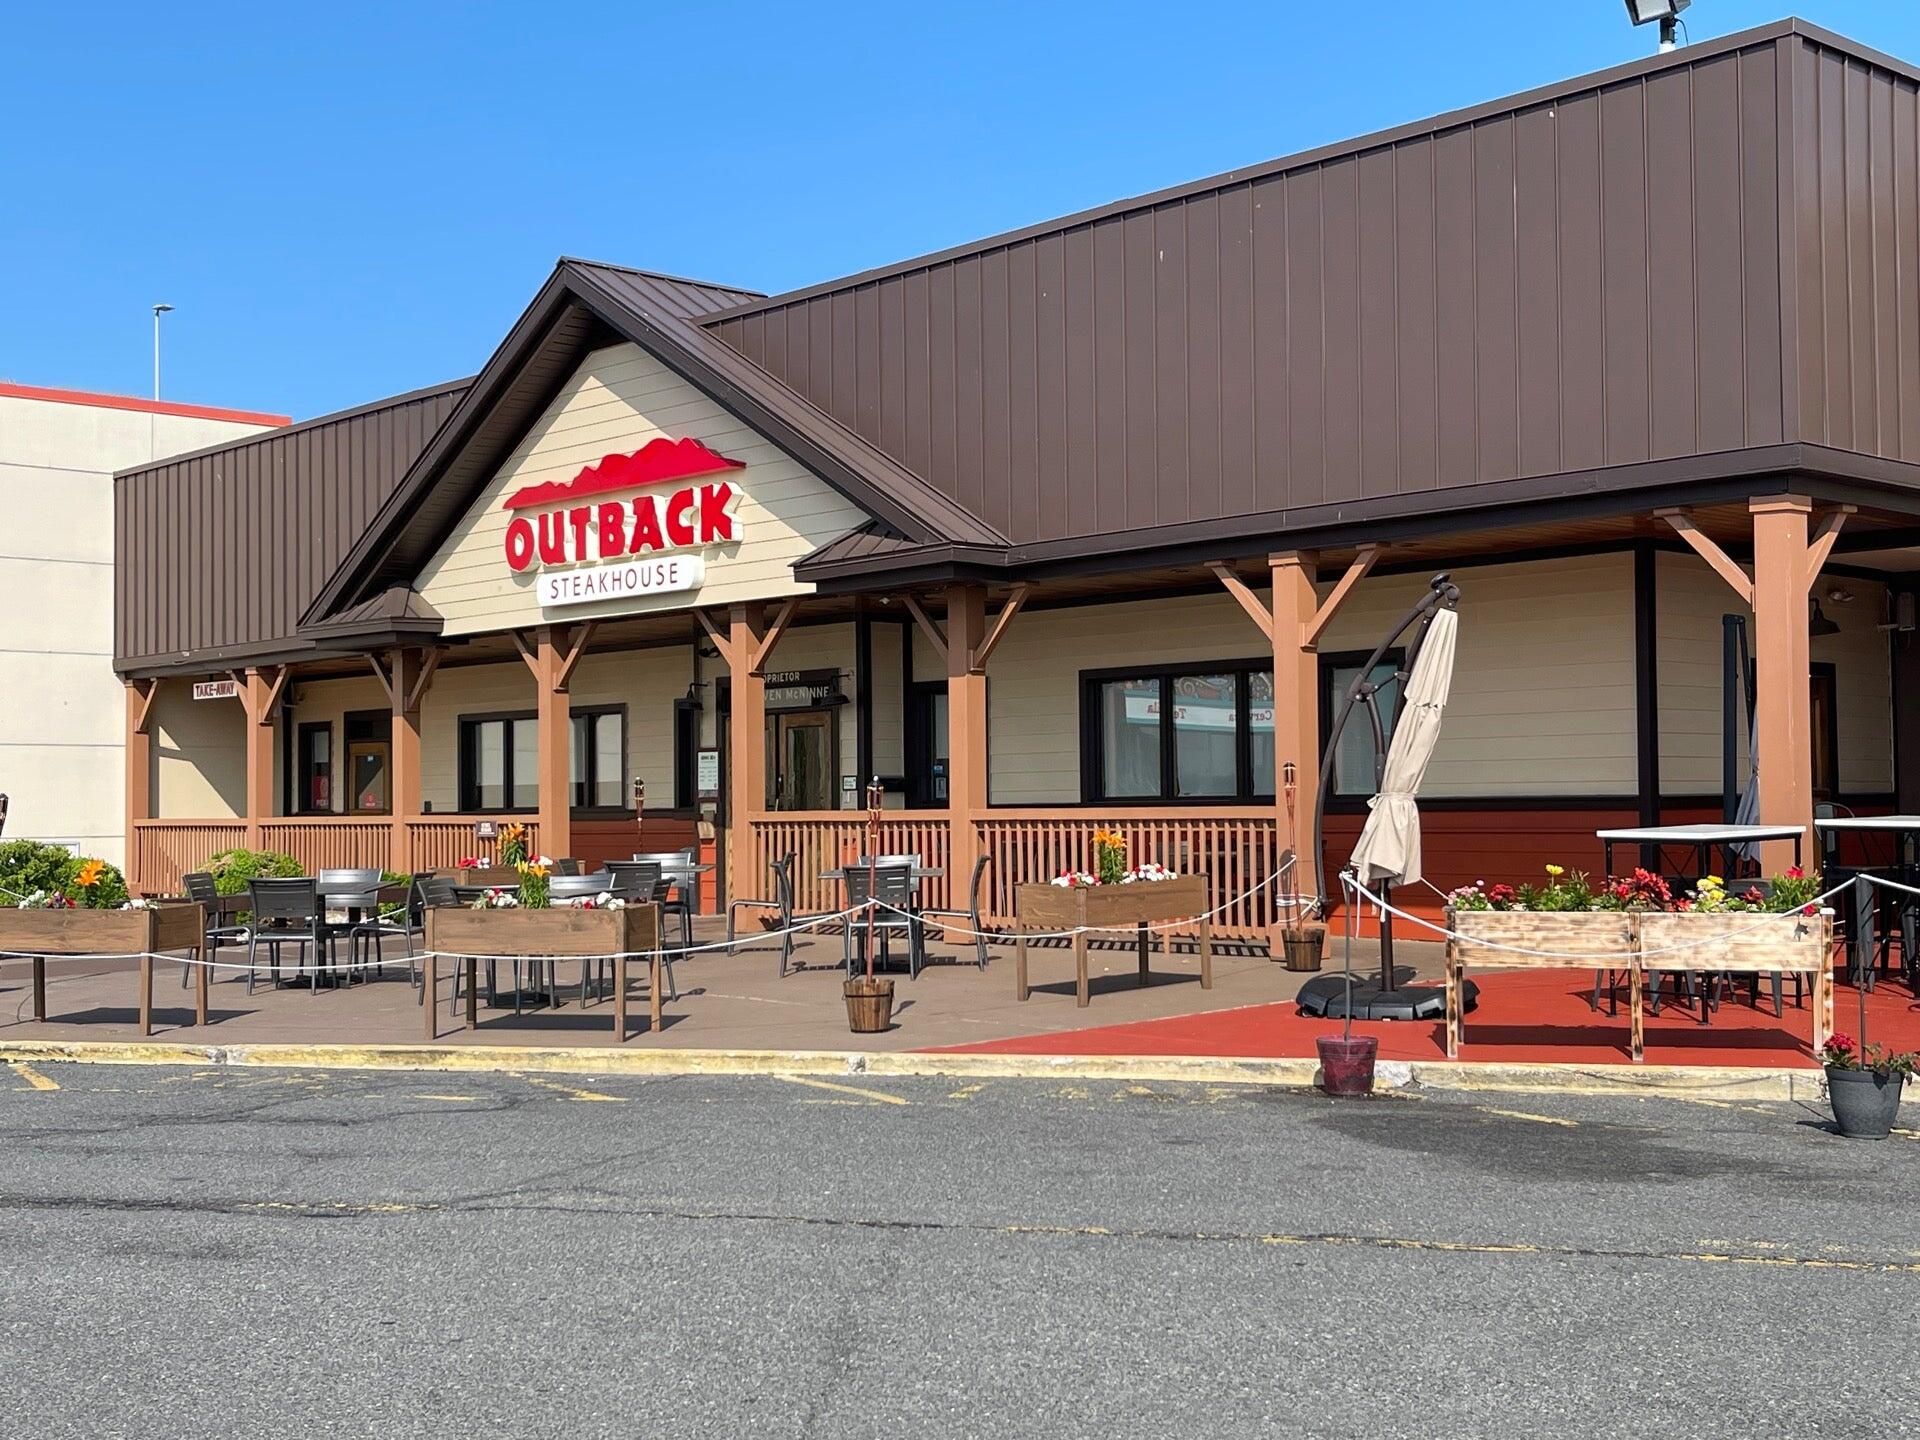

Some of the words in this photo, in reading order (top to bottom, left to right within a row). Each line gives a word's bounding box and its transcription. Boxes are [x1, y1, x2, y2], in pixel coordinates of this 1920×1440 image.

[504, 481, 742, 573] OUTBACK
[550, 562, 679, 600] STEAKHOUSE
[195, 683, 235, 697] TAKE-AWAY
